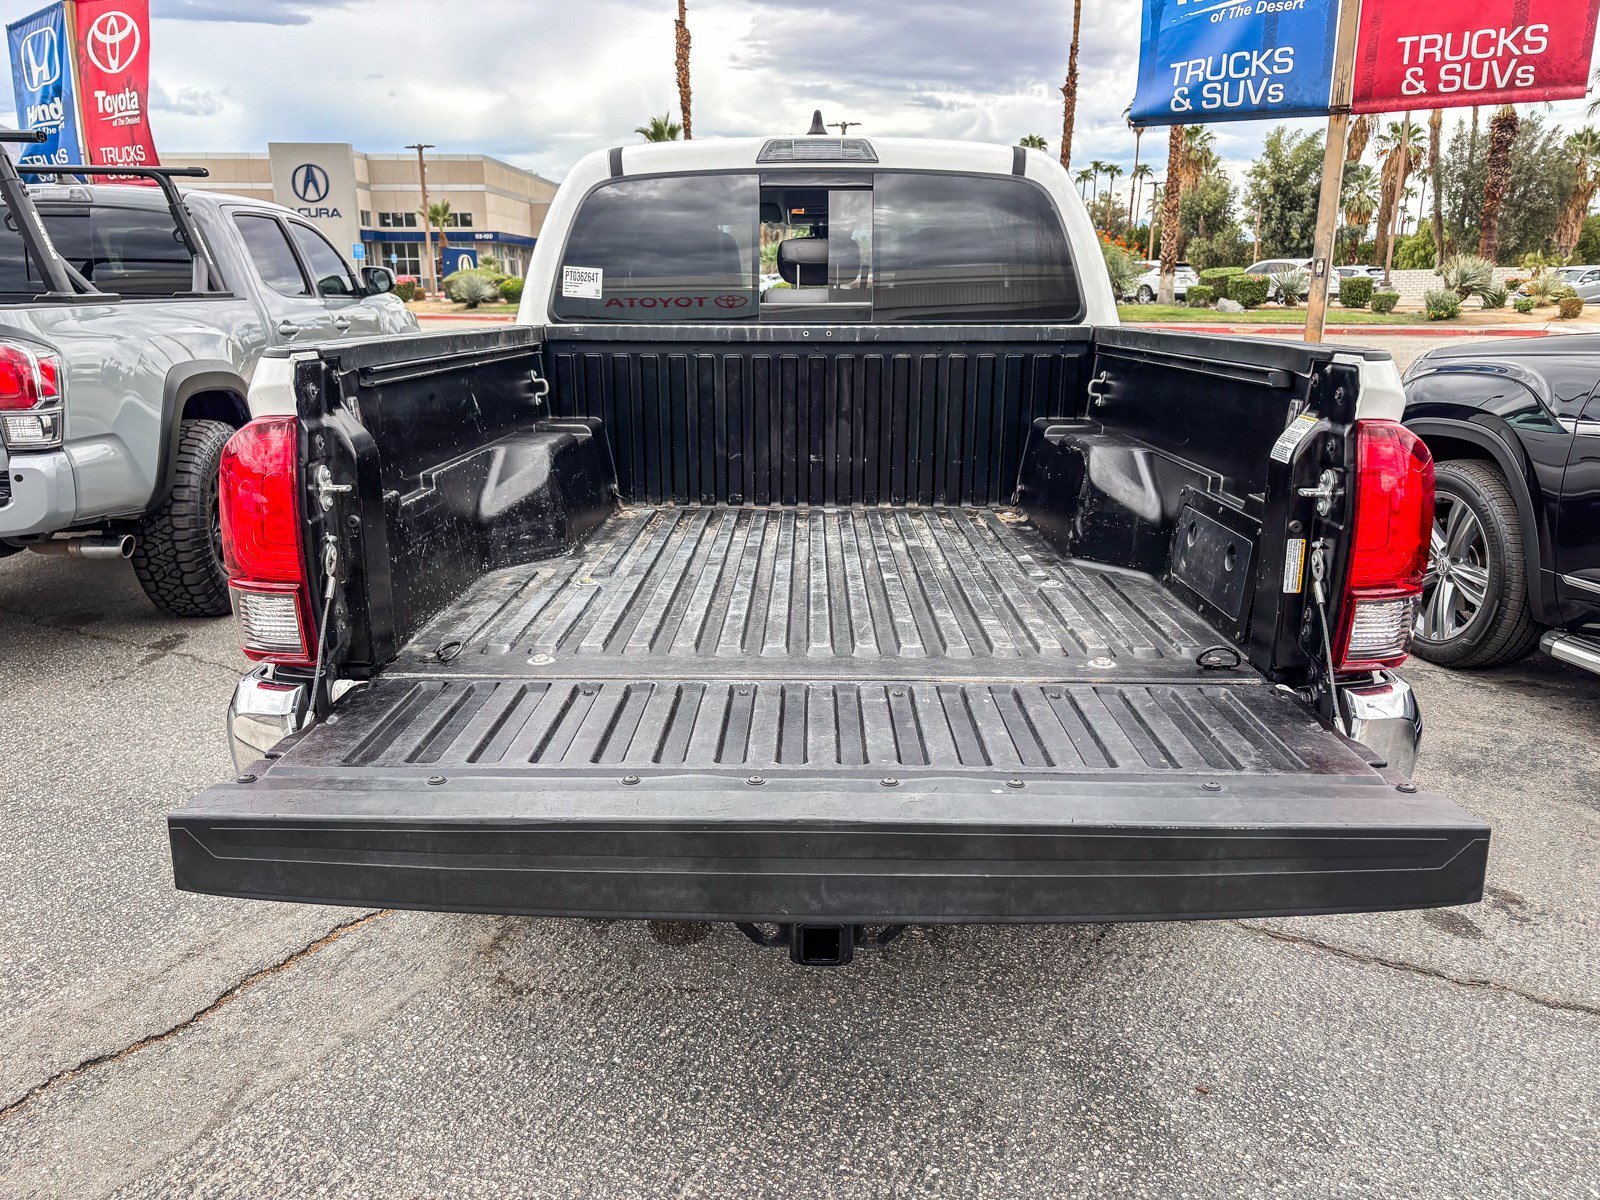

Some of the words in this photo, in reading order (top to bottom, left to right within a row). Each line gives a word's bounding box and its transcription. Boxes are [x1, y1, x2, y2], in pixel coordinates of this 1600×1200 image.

[1210, 9, 1226, 23] of
[1228, 5, 1253, 19] The
[1255, 0, 1304, 14] Desert
[1398, 23, 1549, 65] TRUCKS
[1169, 46, 1295, 87] TRUCKS
[1401, 66, 1428, 96] &
[1438, 58, 1536, 93] SUVs
[93, 87, 139, 115] Toyota
[1170, 86, 1193, 112] &
[1201, 77, 1285, 109] SUVs
[100, 144, 147, 164] TRUCKS
[290, 207, 342, 219] CURA
